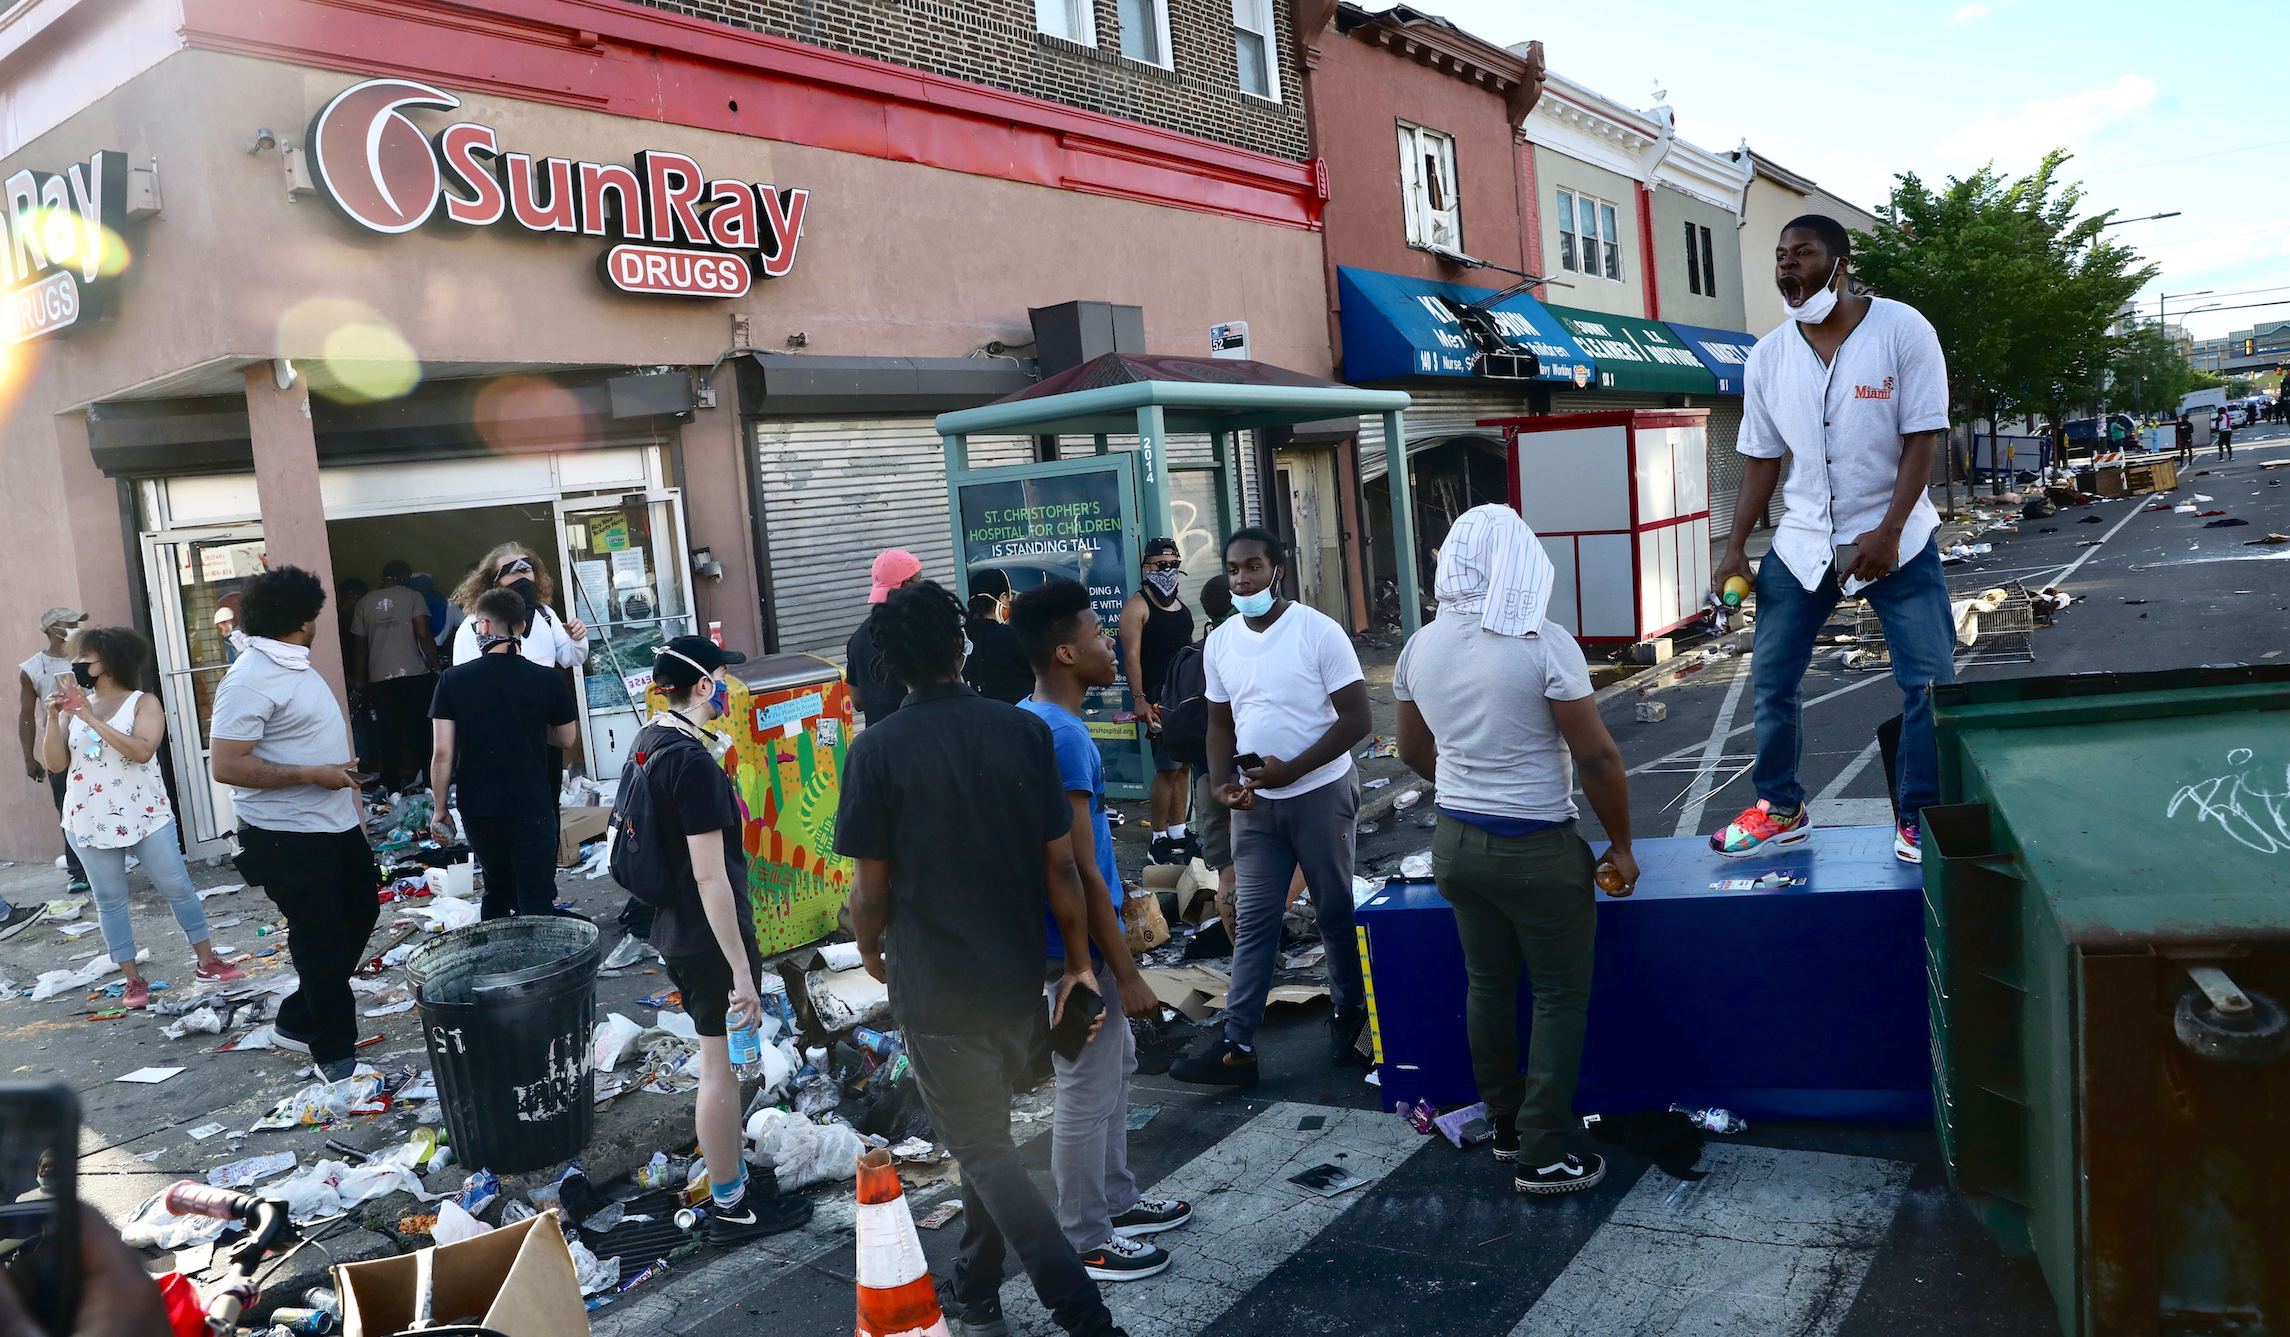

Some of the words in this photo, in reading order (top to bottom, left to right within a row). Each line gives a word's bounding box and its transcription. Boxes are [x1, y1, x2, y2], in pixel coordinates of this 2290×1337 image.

[441, 121, 811, 278] SunRay
[619, 251, 740, 292] DRUGS
[4, 280, 74, 333] RUGS
[1213, 338, 1224, 351] 52
[1572, 336, 1643, 362] CLEANERS
[1644, 344, 1705, 368] BOUTIQUE
[1552, 363, 1572, 379] Working
[1855, 385, 1891, 399] Miami
[1143, 437, 1154, 484] 2014
[985, 511, 1000, 523] ST.
[1004, 501, 1100, 522] CHRISTOPHER'S
[969, 526, 1025, 542] HOSPITAL
[1028, 524, 1053, 537] FOR
[1057, 518, 1122, 535] CHILDREN
[992, 544, 1002, 557] IS
[1006, 540, 1067, 556] STANDING
[1071, 538, 1101, 551] TALL
[1089, 586, 1112, 596] DING
[1113, 586, 1121, 594] A
[1100, 600, 1122, 610] WITH
[1088, 726, 1134, 736] ersHospital.org
